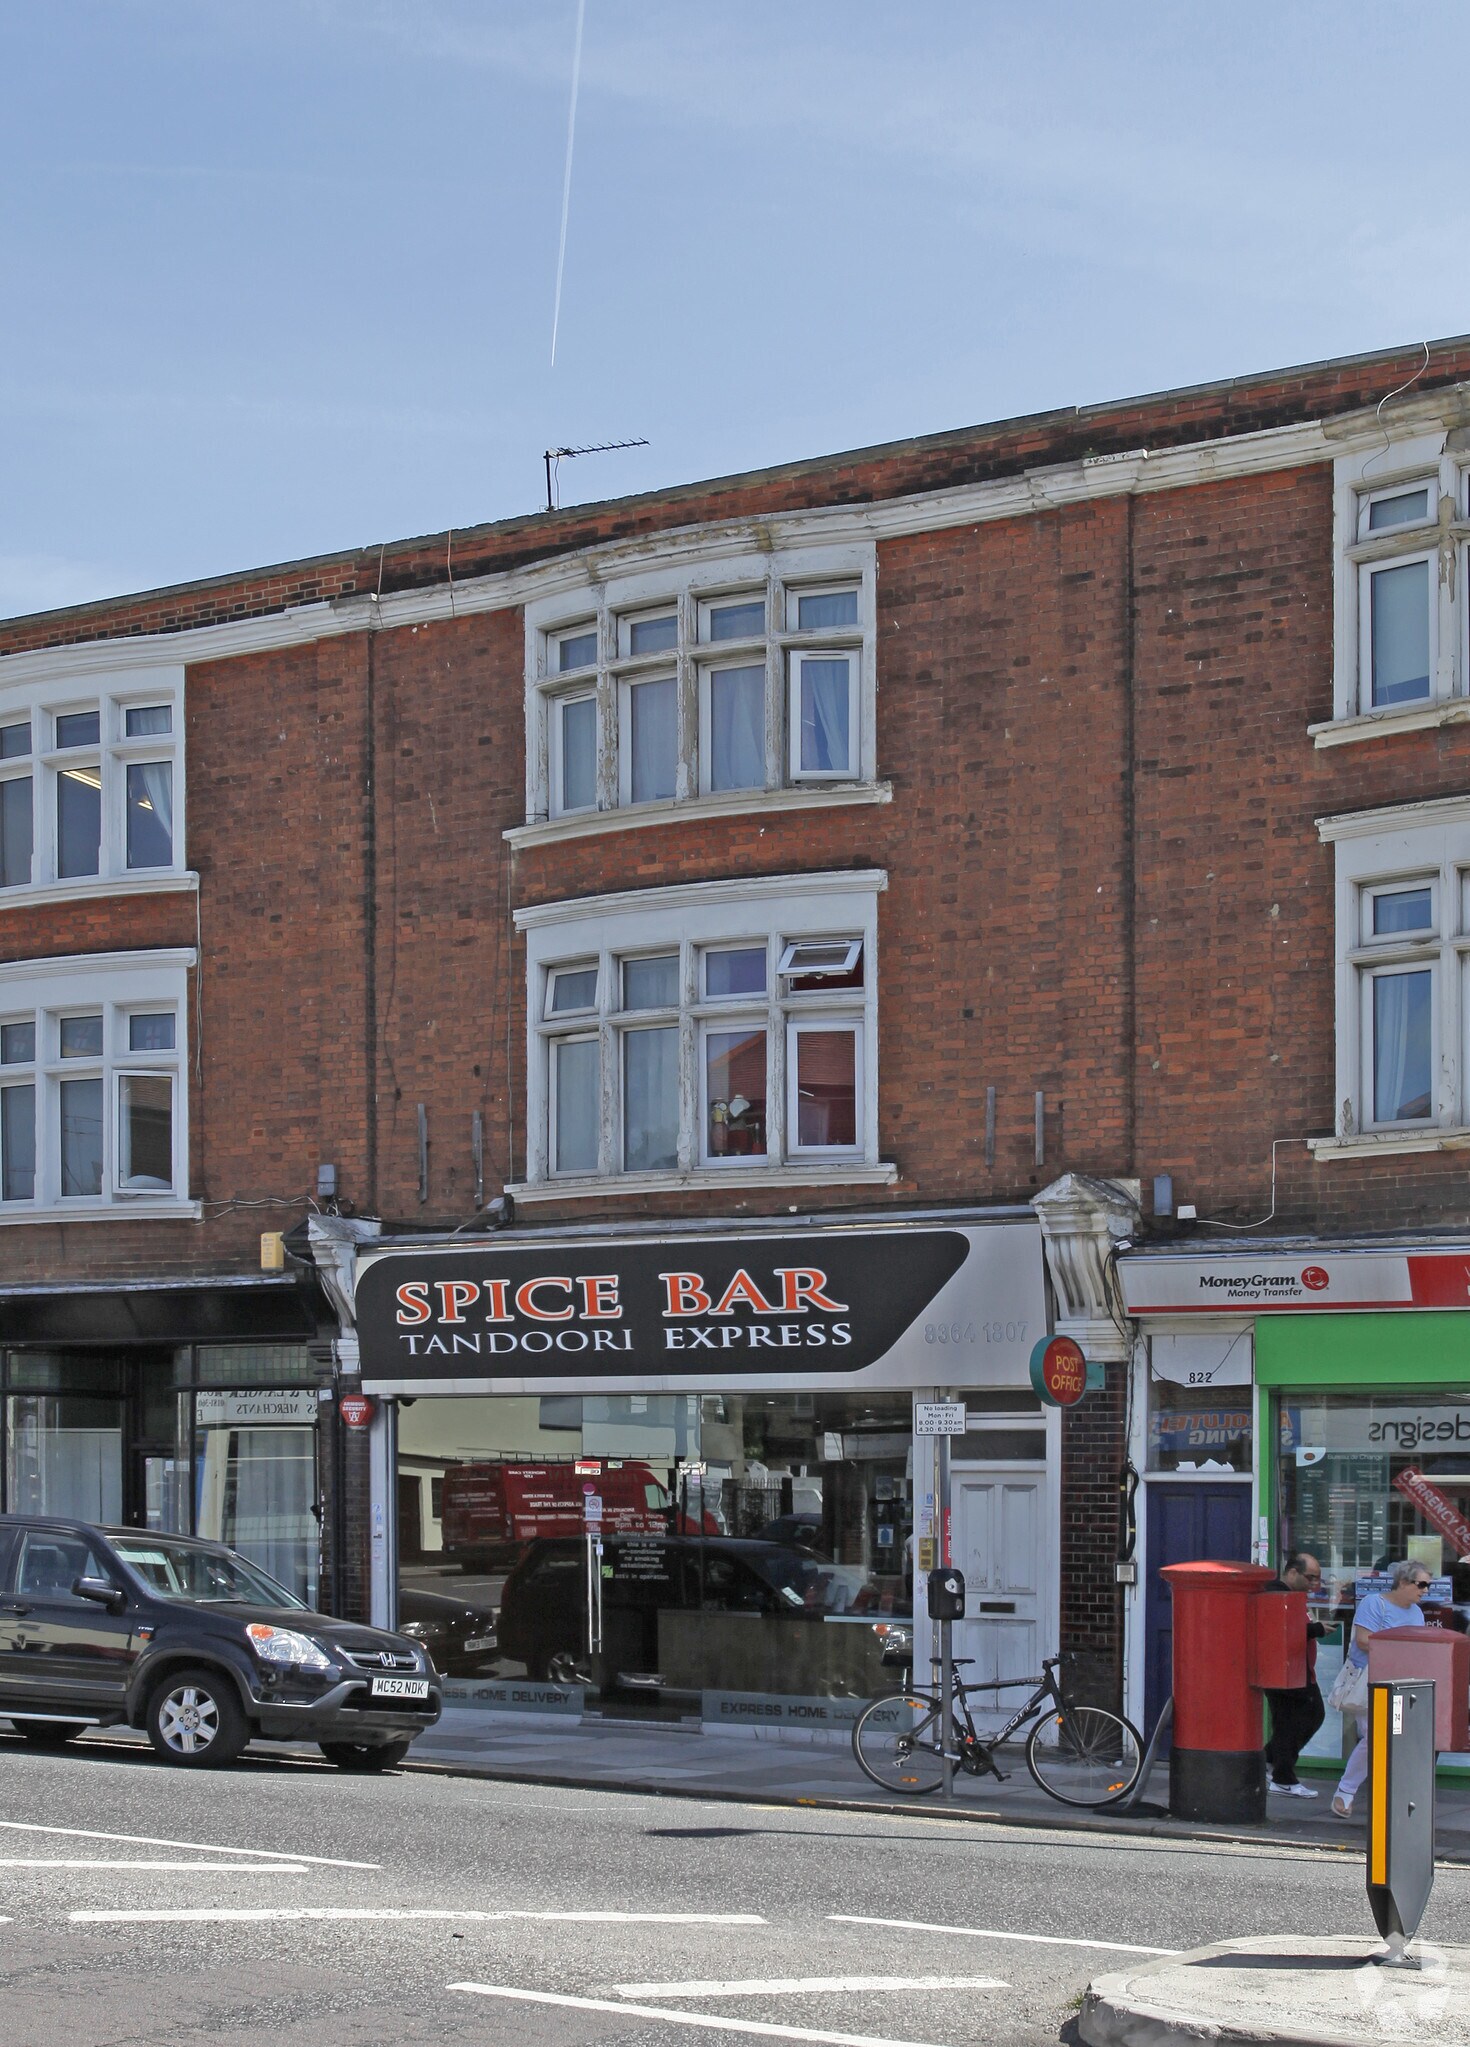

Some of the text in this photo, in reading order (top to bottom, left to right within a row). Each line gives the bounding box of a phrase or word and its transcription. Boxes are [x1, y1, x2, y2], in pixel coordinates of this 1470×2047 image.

[1199, 1274, 1296, 1289] MoneyGram
[395, 1267, 850, 1326] SPICE BAR
[1227, 1287, 1302, 1299] Money Transfer
[399, 1322, 853, 1356] TANDOORI EXPRESS
[924, 1321, 1028, 1344] 8364 1807
[1051, 1355, 1082, 1392] POST OFFICE
[1189, 1372, 1212, 1383] 822
[1359, 1453, 1383, 1461] Change
[1403, 1470, 1459, 1526] CURRENCY
[404, 1681, 425, 1695] NDK
[473, 1689, 507, 1700] HOME
[512, 1691, 570, 1704] DELIVERY
[720, 1702, 782, 1716] EXPRESS
[788, 1705, 828, 1719] HOME
